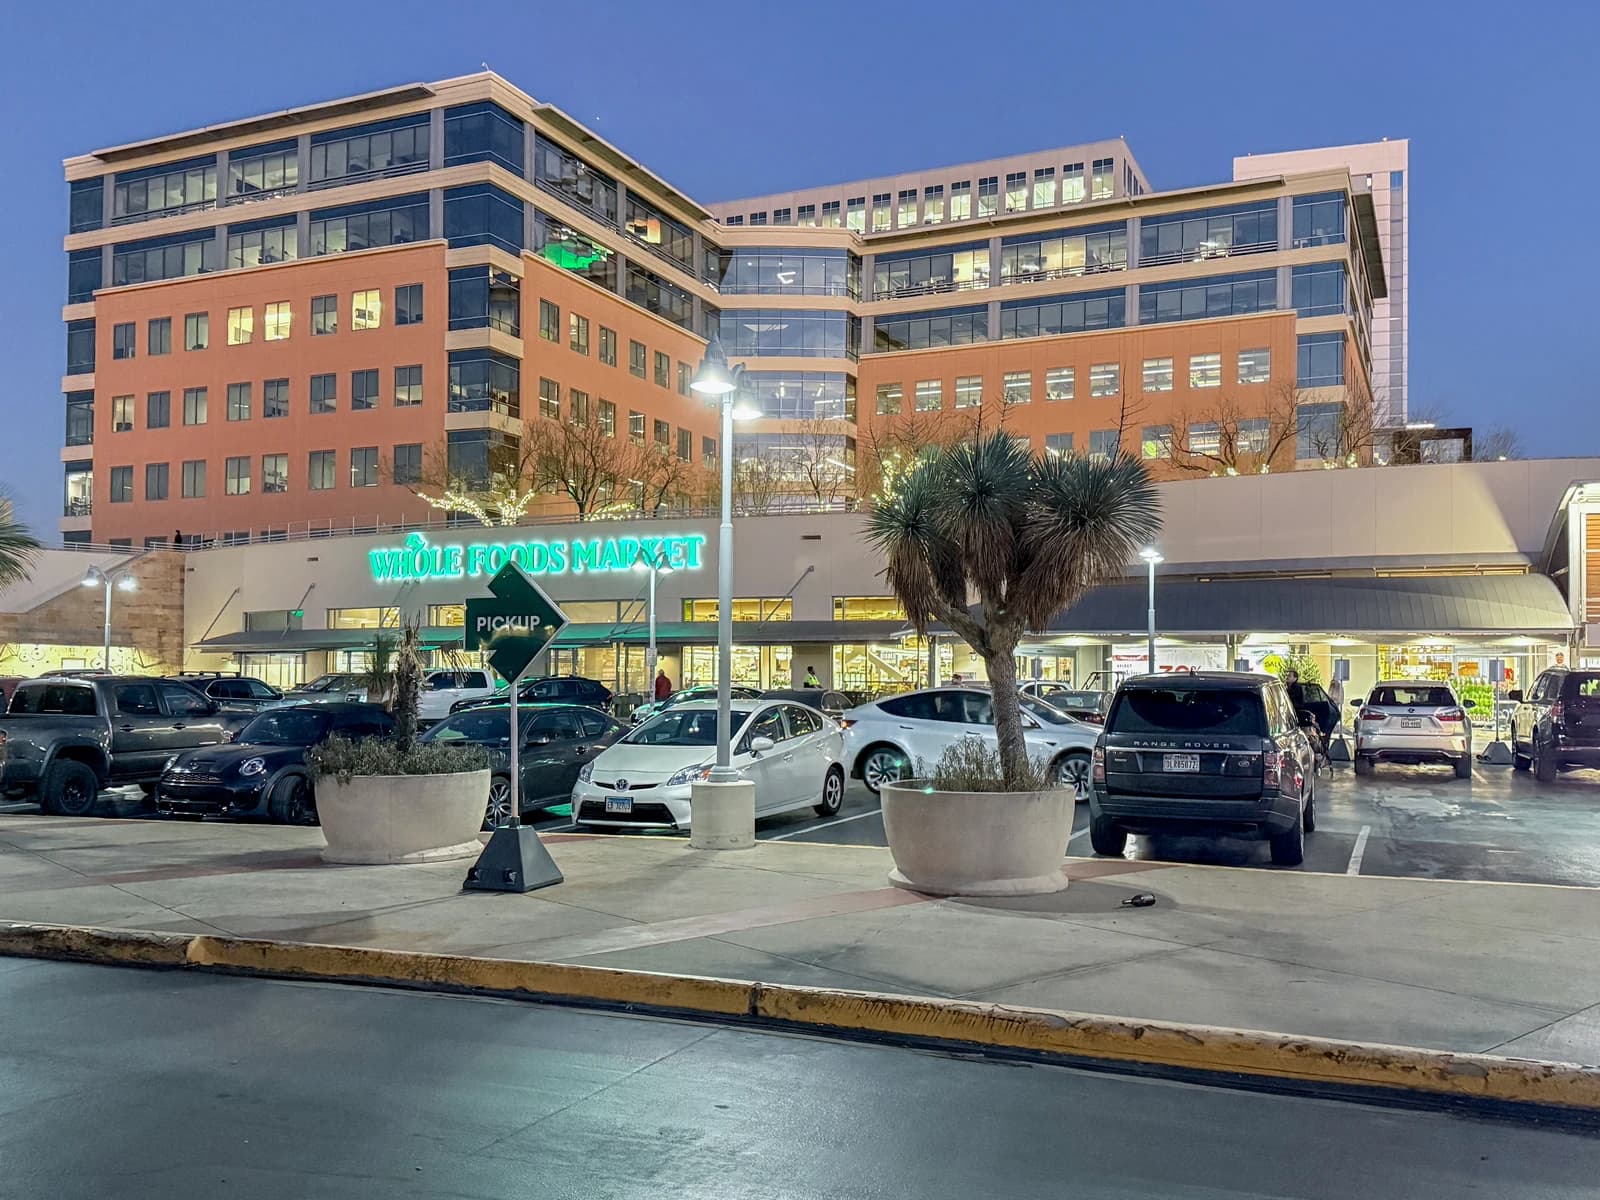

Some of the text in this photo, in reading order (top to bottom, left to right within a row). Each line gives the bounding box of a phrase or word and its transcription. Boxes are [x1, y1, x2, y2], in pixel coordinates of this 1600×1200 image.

[367, 541, 463, 581] WHOLE
[466, 540, 565, 576] FOODS
[476, 615, 541, 632] PICKUP
[1133, 740, 1231, 749] RANGE ROVER
